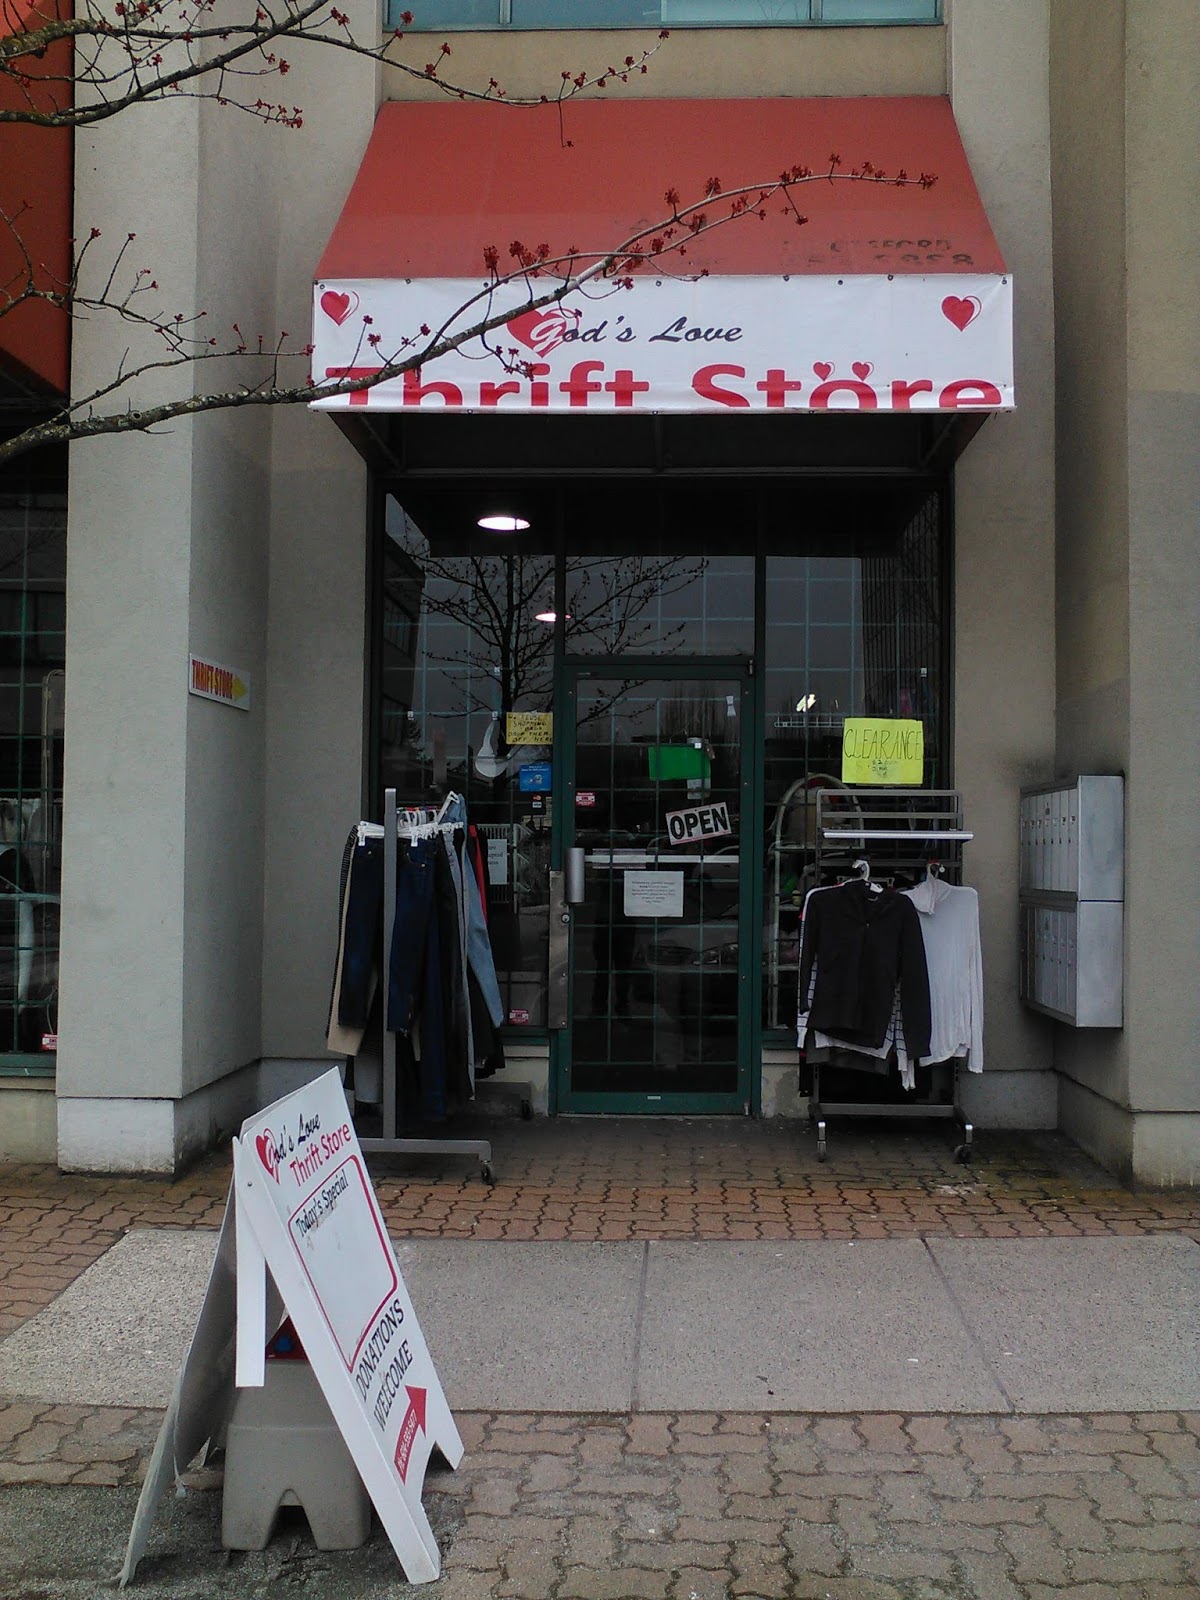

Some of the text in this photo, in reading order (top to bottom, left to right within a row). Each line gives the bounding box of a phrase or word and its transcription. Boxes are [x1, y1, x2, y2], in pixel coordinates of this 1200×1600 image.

[531, 312, 743, 350] God's Love
[325, 360, 650, 407] Thrift
[844, 727, 922, 760] CLEARANCE
[669, 806, 729, 840] OPEN
[265, 1113, 320, 1167] God's Love
[289, 1123, 352, 1187] Thrift Store
[295, 1168, 349, 1237] Today's Special
[356, 1298, 404, 1403] DONATIONS
[373, 1339, 413, 1432] WELCOME
